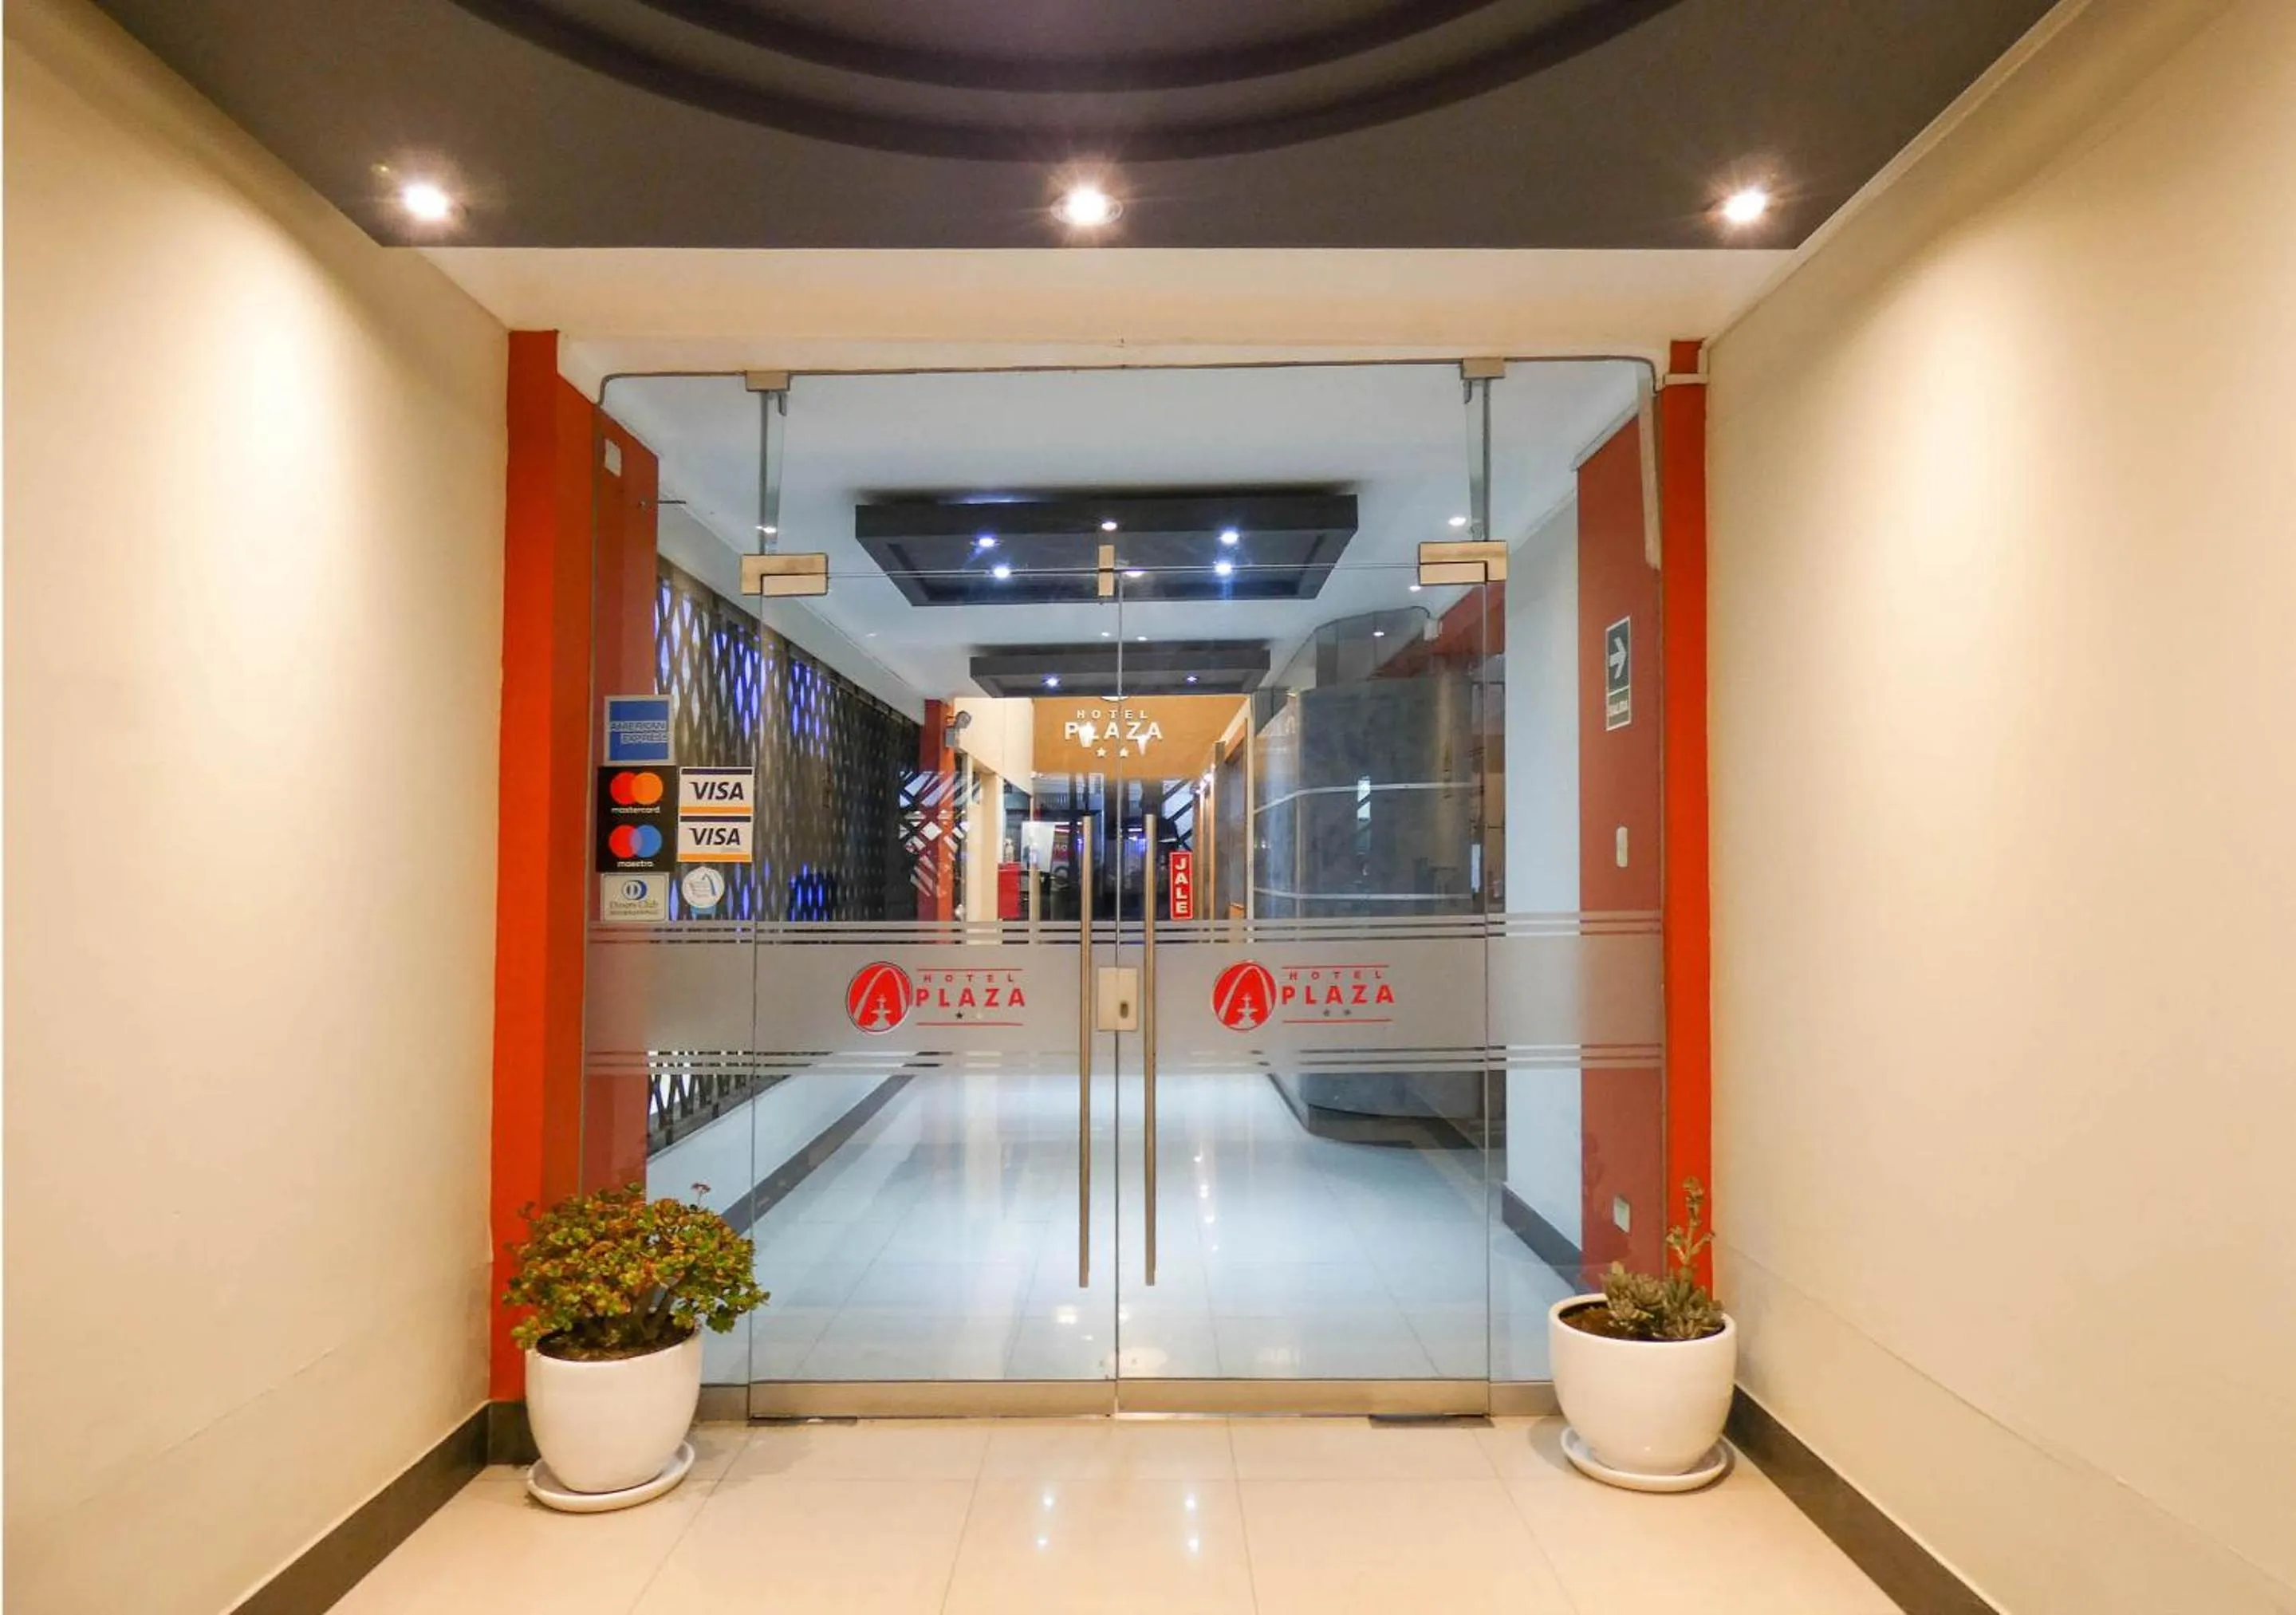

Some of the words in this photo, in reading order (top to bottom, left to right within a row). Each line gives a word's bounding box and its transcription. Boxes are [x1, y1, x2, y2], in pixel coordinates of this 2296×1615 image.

[1077, 709, 1149, 719] HOTEL
[1064, 722, 1164, 740] PLAZA
[690, 782, 744, 801] VISA
[690, 827, 741, 845] VISA
[1175, 857, 1188, 914] JALE
[923, 974, 1014, 983] HOTEL
[1289, 970, 1383, 980] HOTEL
[916, 987, 1026, 1008] PLAZA
[1281, 984, 1395, 1005] PLAZA
